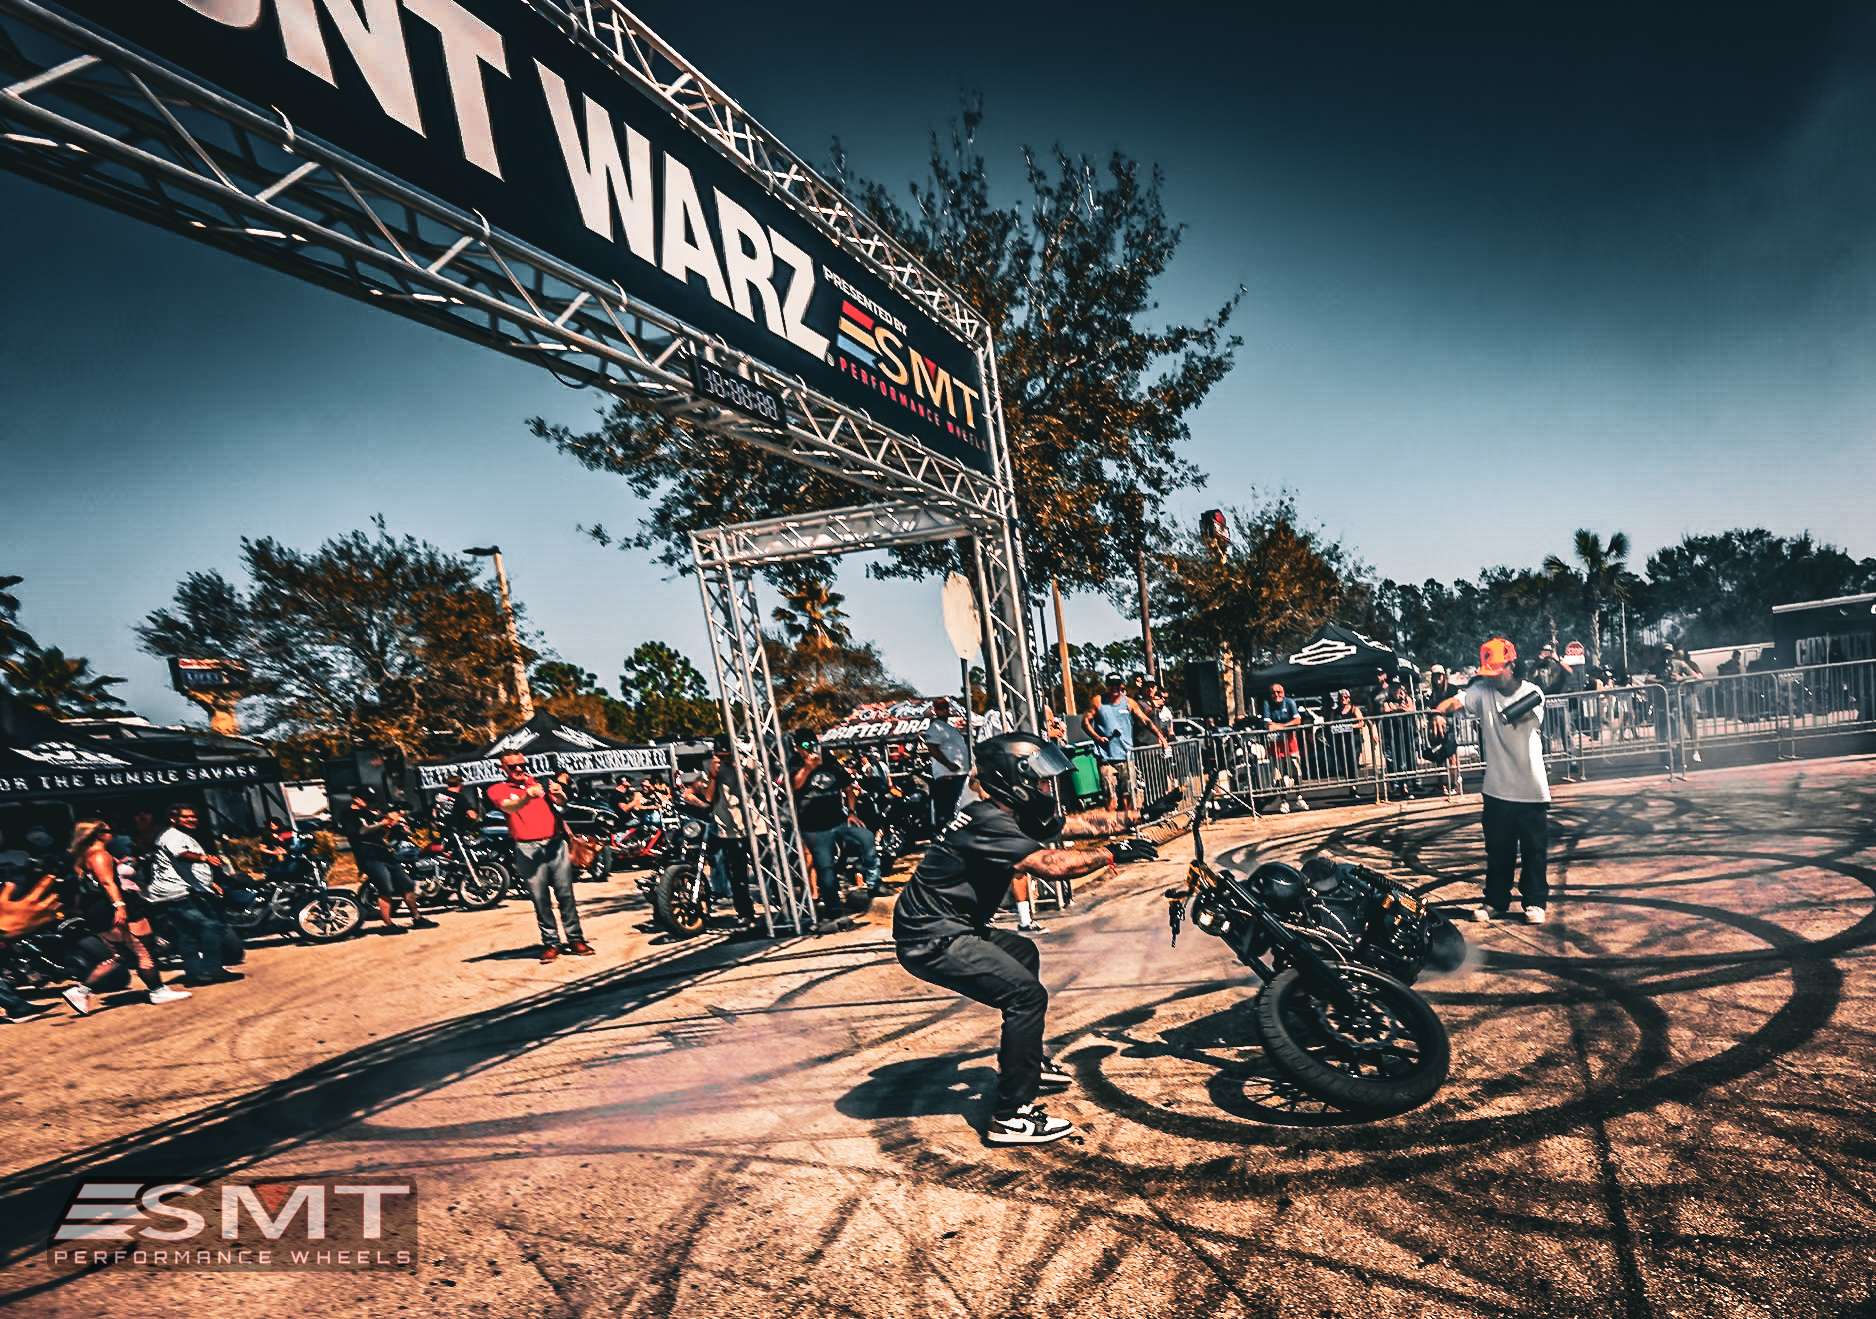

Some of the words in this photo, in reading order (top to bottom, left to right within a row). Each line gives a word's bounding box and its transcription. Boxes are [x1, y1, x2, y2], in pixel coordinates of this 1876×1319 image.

[533, 57, 830, 361] WARZ
[822, 264, 894, 326] PRESENTED
[893, 316, 908, 336] BY
[838, 355, 941, 427] PERFORMANCE
[38, 774, 86, 791] THE
